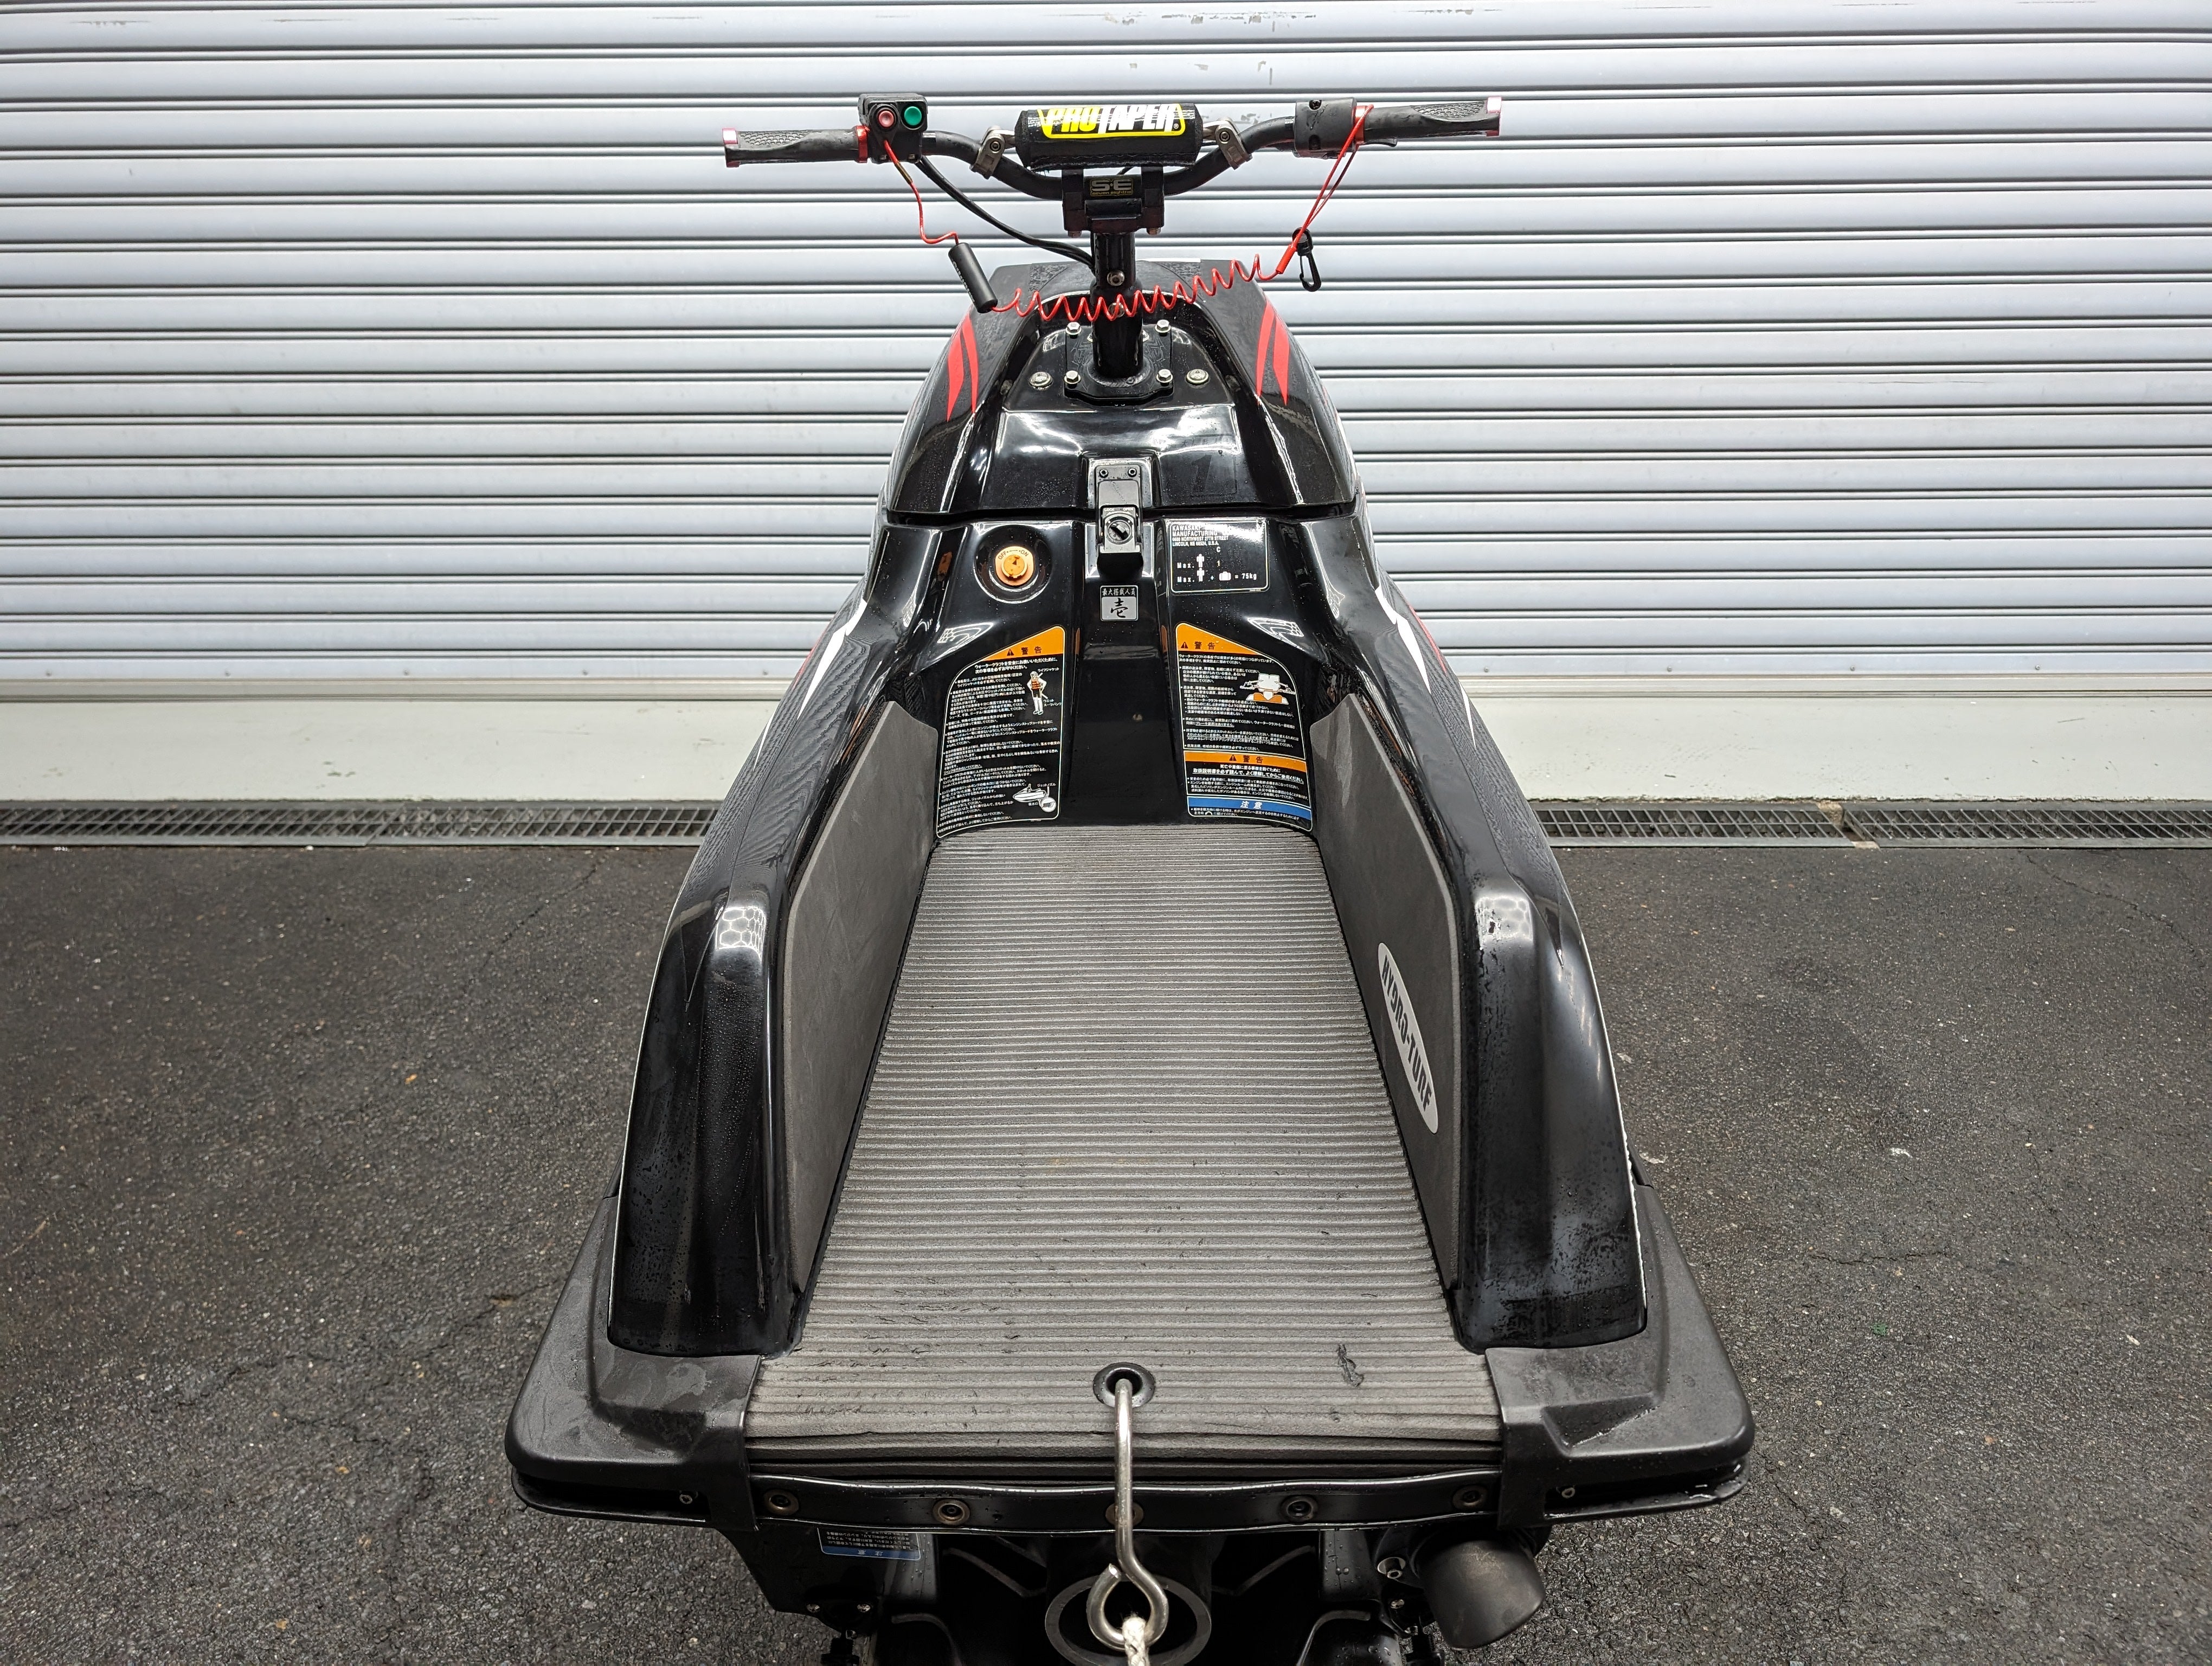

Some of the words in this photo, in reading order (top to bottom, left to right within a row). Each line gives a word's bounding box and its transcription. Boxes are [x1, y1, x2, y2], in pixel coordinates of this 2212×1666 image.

[998, 551, 1006, 560] OFF
[1194, 641, 1216, 650] 警告
[1021, 646, 1042, 655] 警告
[1242, 755, 1264, 764] 警告
[1240, 800, 1263, 810] 注意
[1381, 954, 1432, 1112] HYDRO-TURF
